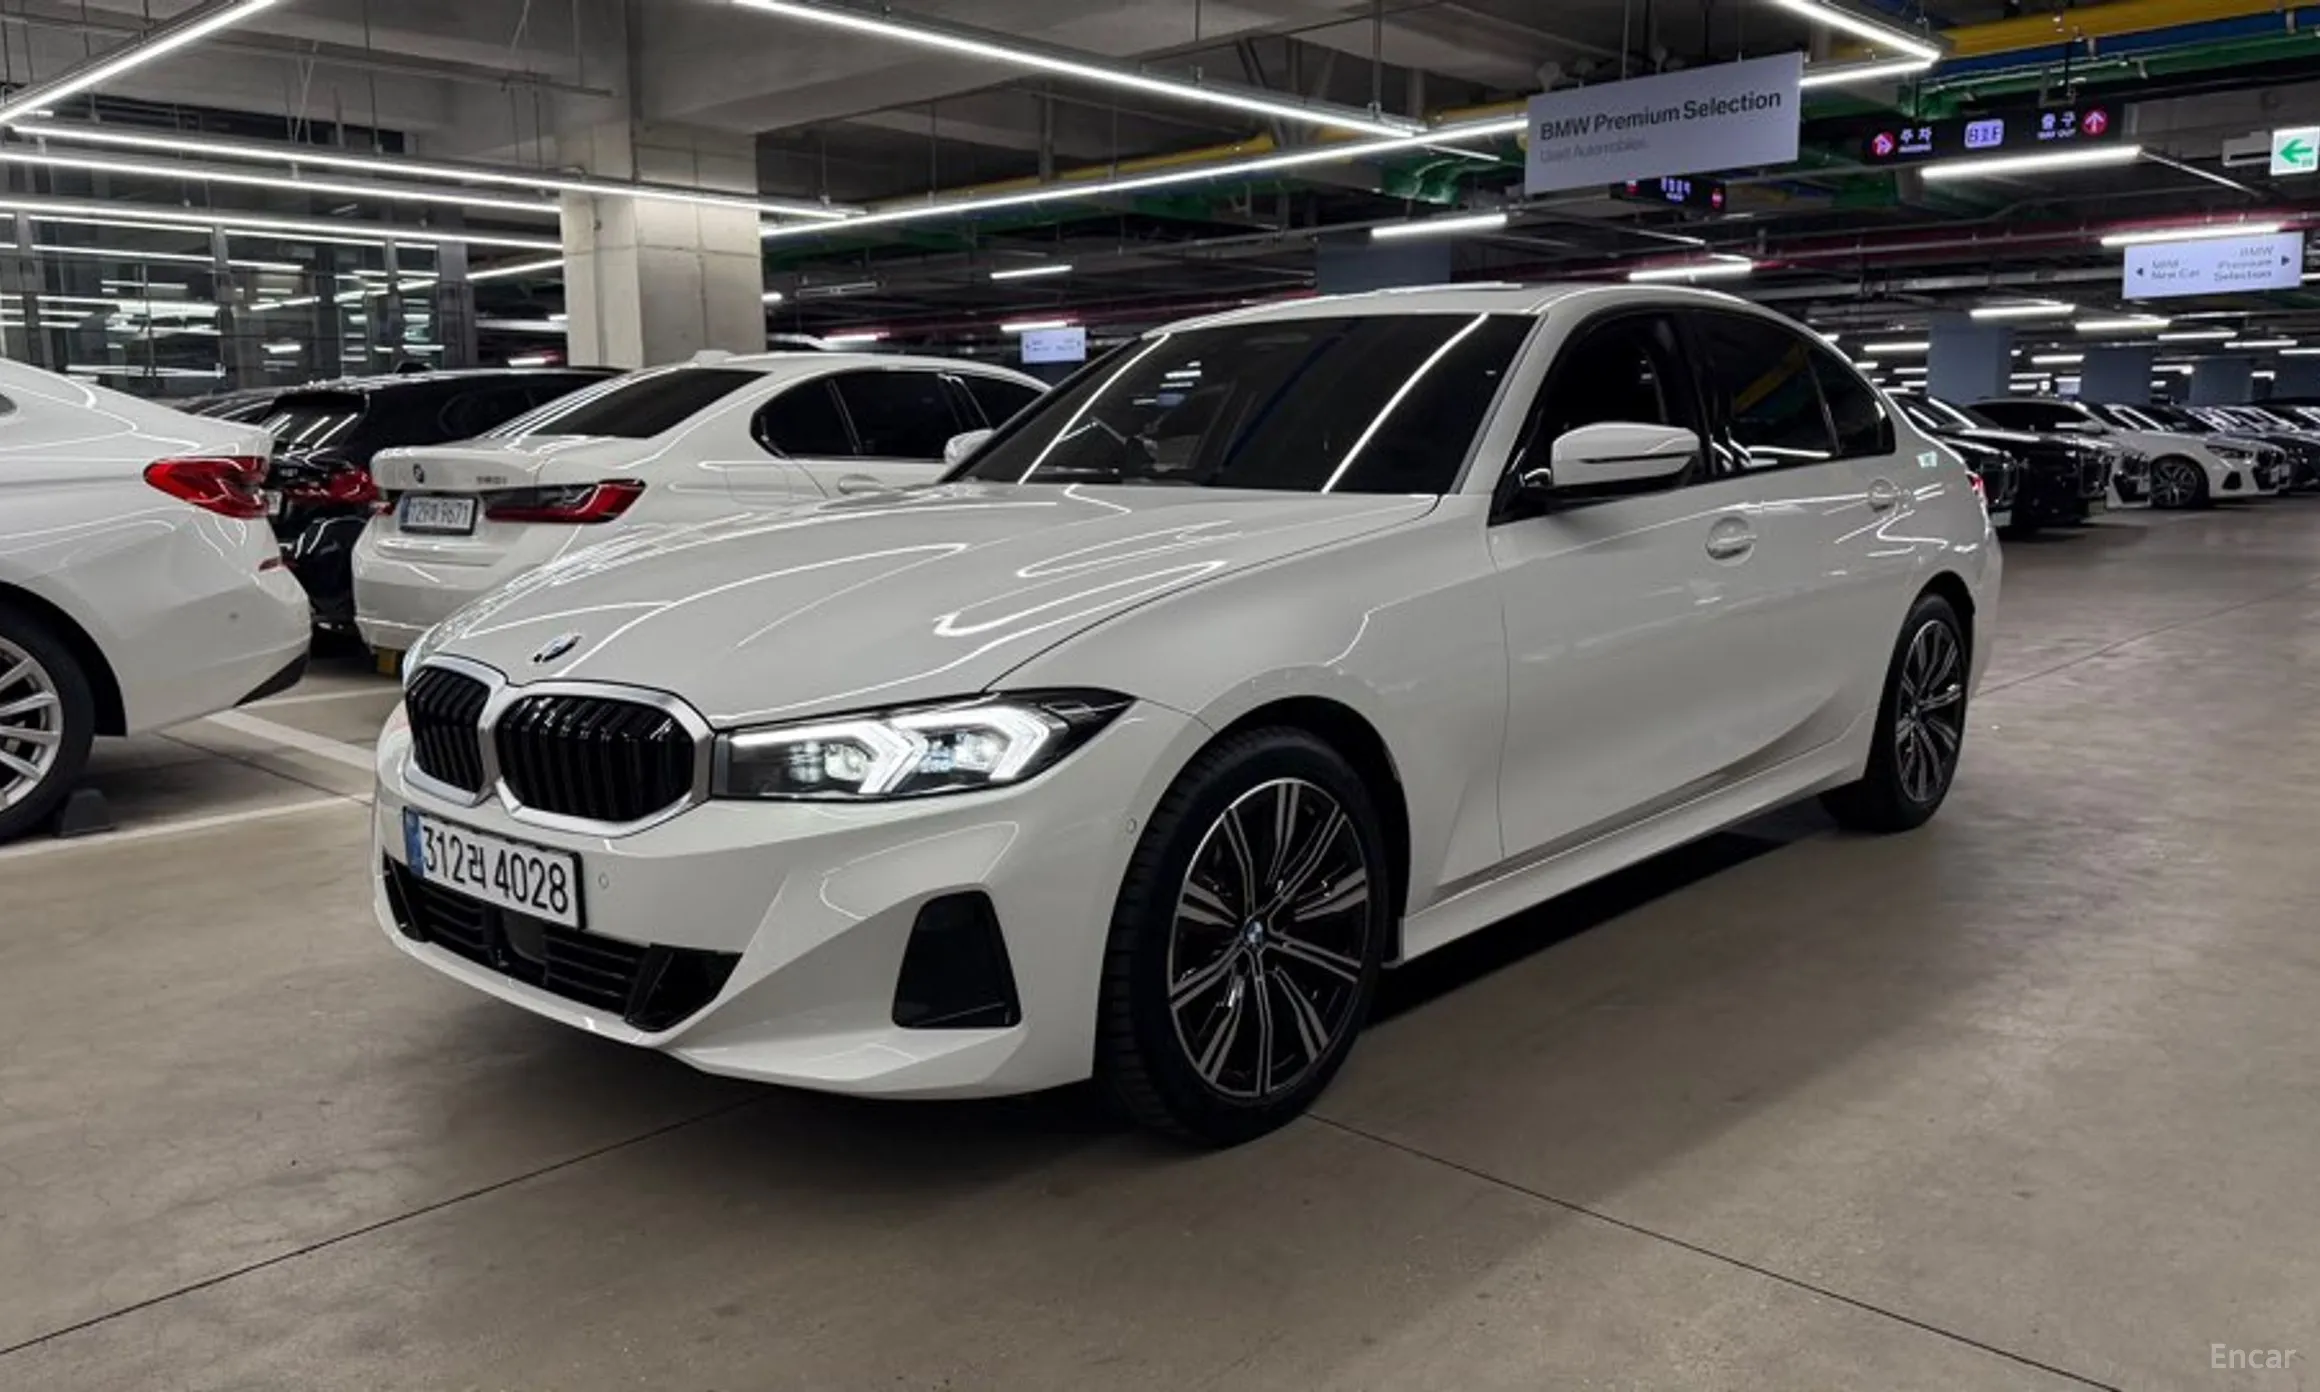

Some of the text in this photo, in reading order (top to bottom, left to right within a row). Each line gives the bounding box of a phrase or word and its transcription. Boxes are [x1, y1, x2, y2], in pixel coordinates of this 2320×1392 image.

[1540, 91, 1781, 141] BMW Premium Selection
[494, 848, 569, 915] 4028
